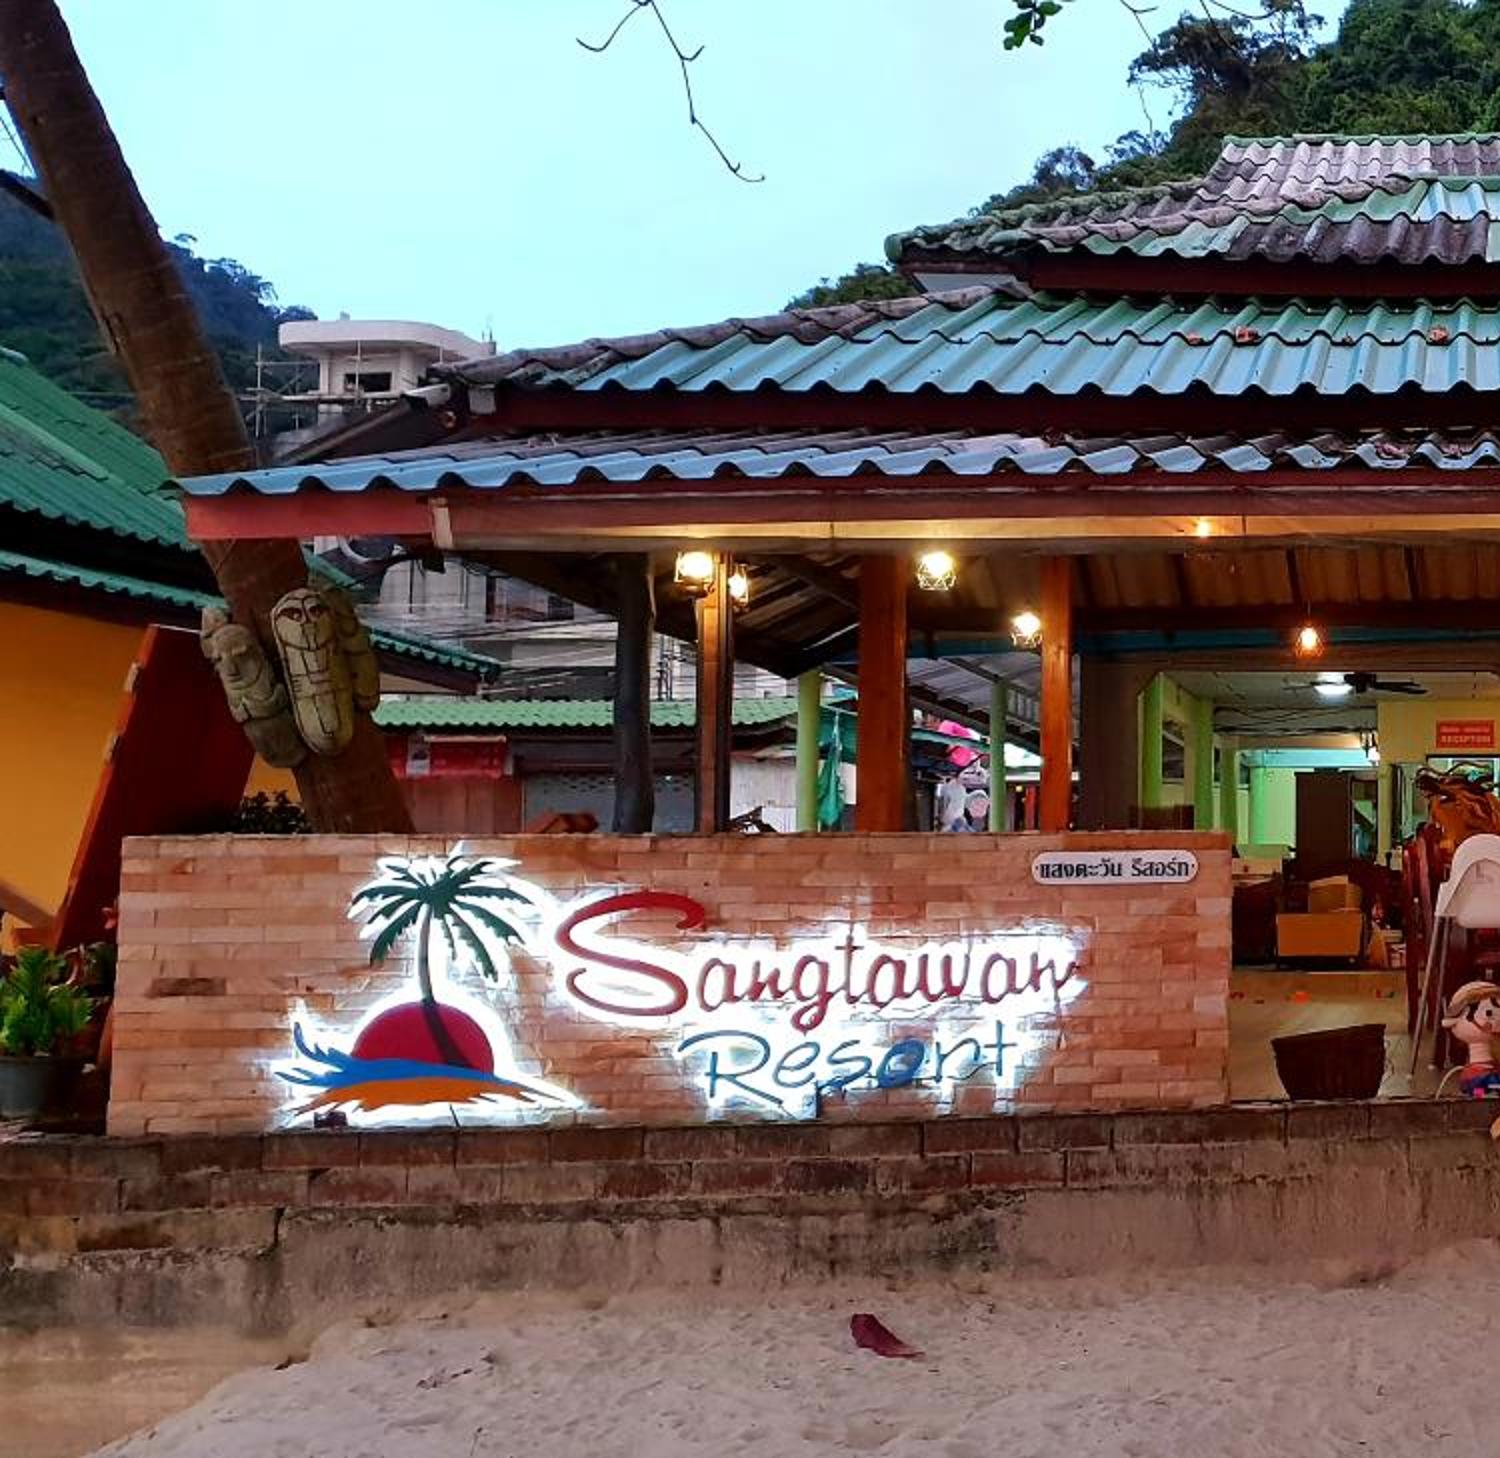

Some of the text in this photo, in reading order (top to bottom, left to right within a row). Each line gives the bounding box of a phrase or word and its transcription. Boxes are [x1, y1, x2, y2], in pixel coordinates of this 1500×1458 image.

[1039, 856, 1190, 879] แสงตะวัน รีสอร์ท
[554, 890, 1080, 1034] Sangtawan
[677, 1019, 1018, 1106] Resort
